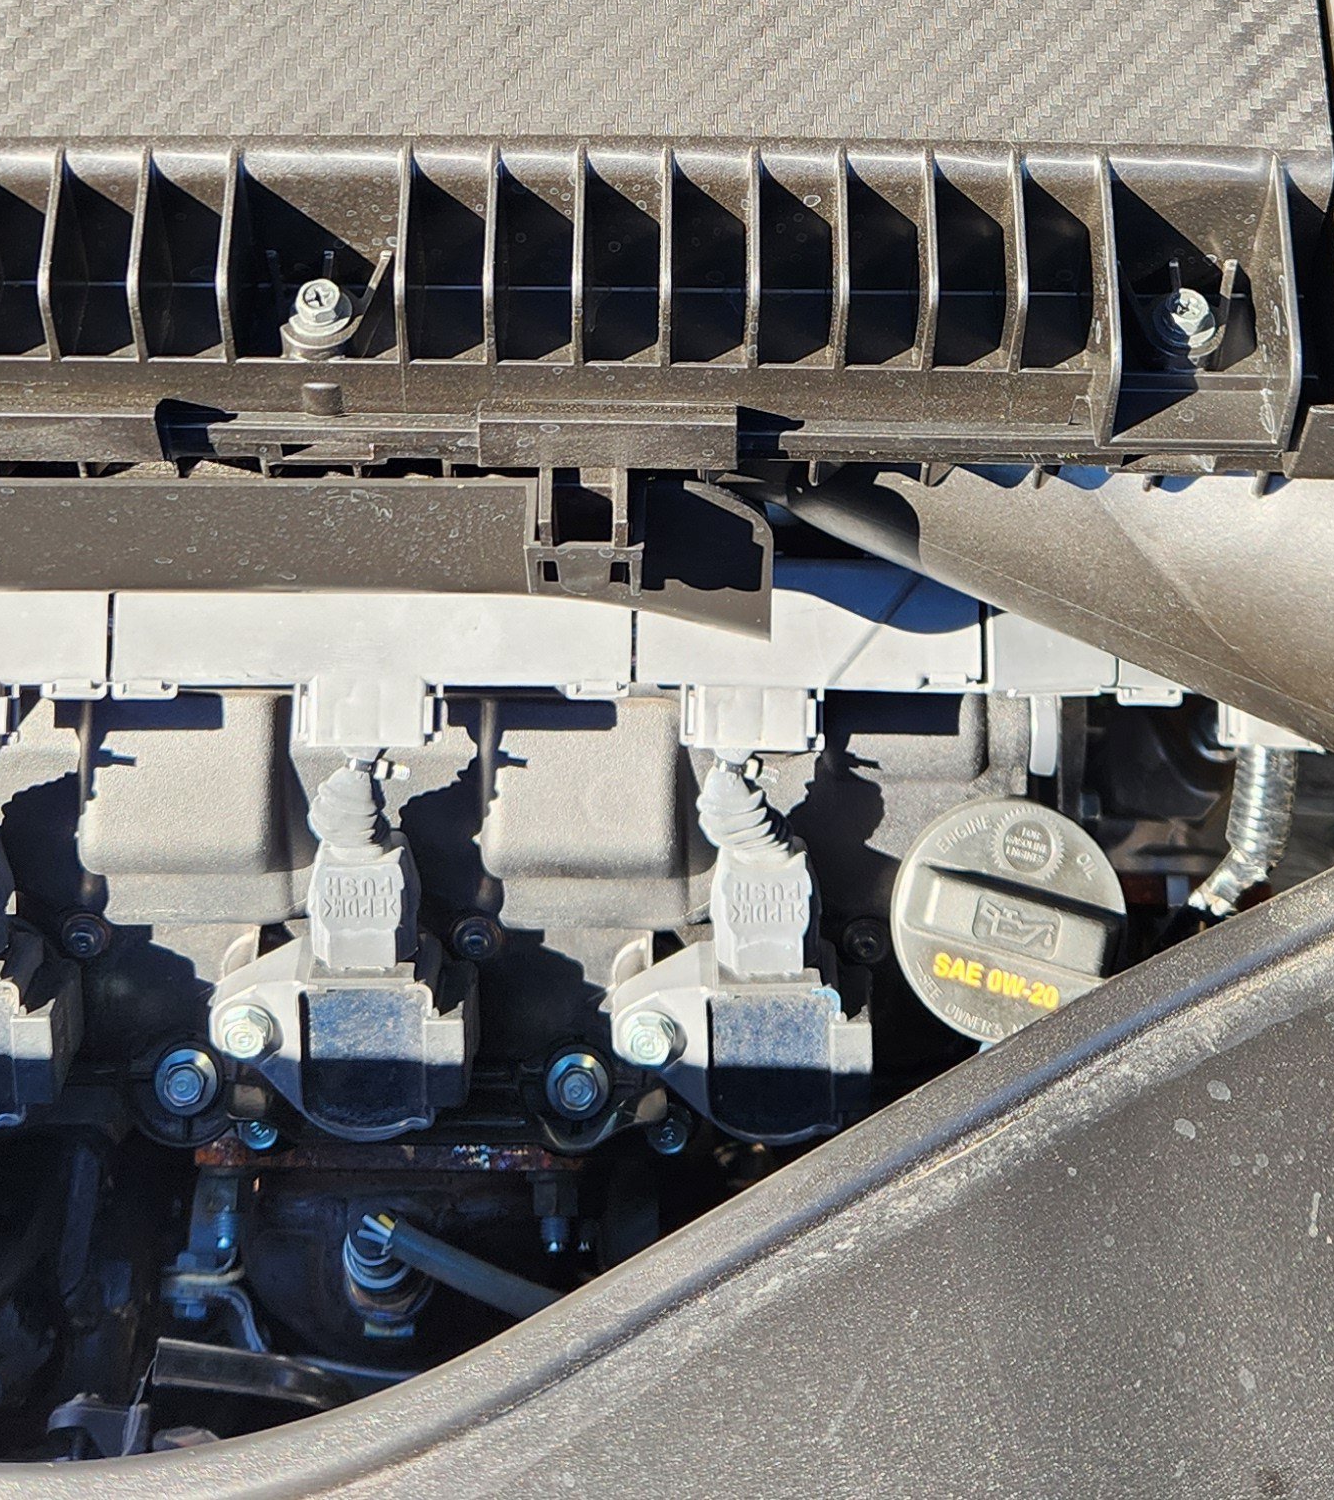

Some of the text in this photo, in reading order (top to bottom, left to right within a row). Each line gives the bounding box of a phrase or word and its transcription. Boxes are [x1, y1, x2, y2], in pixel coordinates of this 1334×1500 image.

[935, 814, 1101, 881] ENGINE OIL
[327, 876, 394, 897] PUSH
[736, 881, 802, 901] PUSH
[932, 952, 1061, 1011] SAE 0W-20
